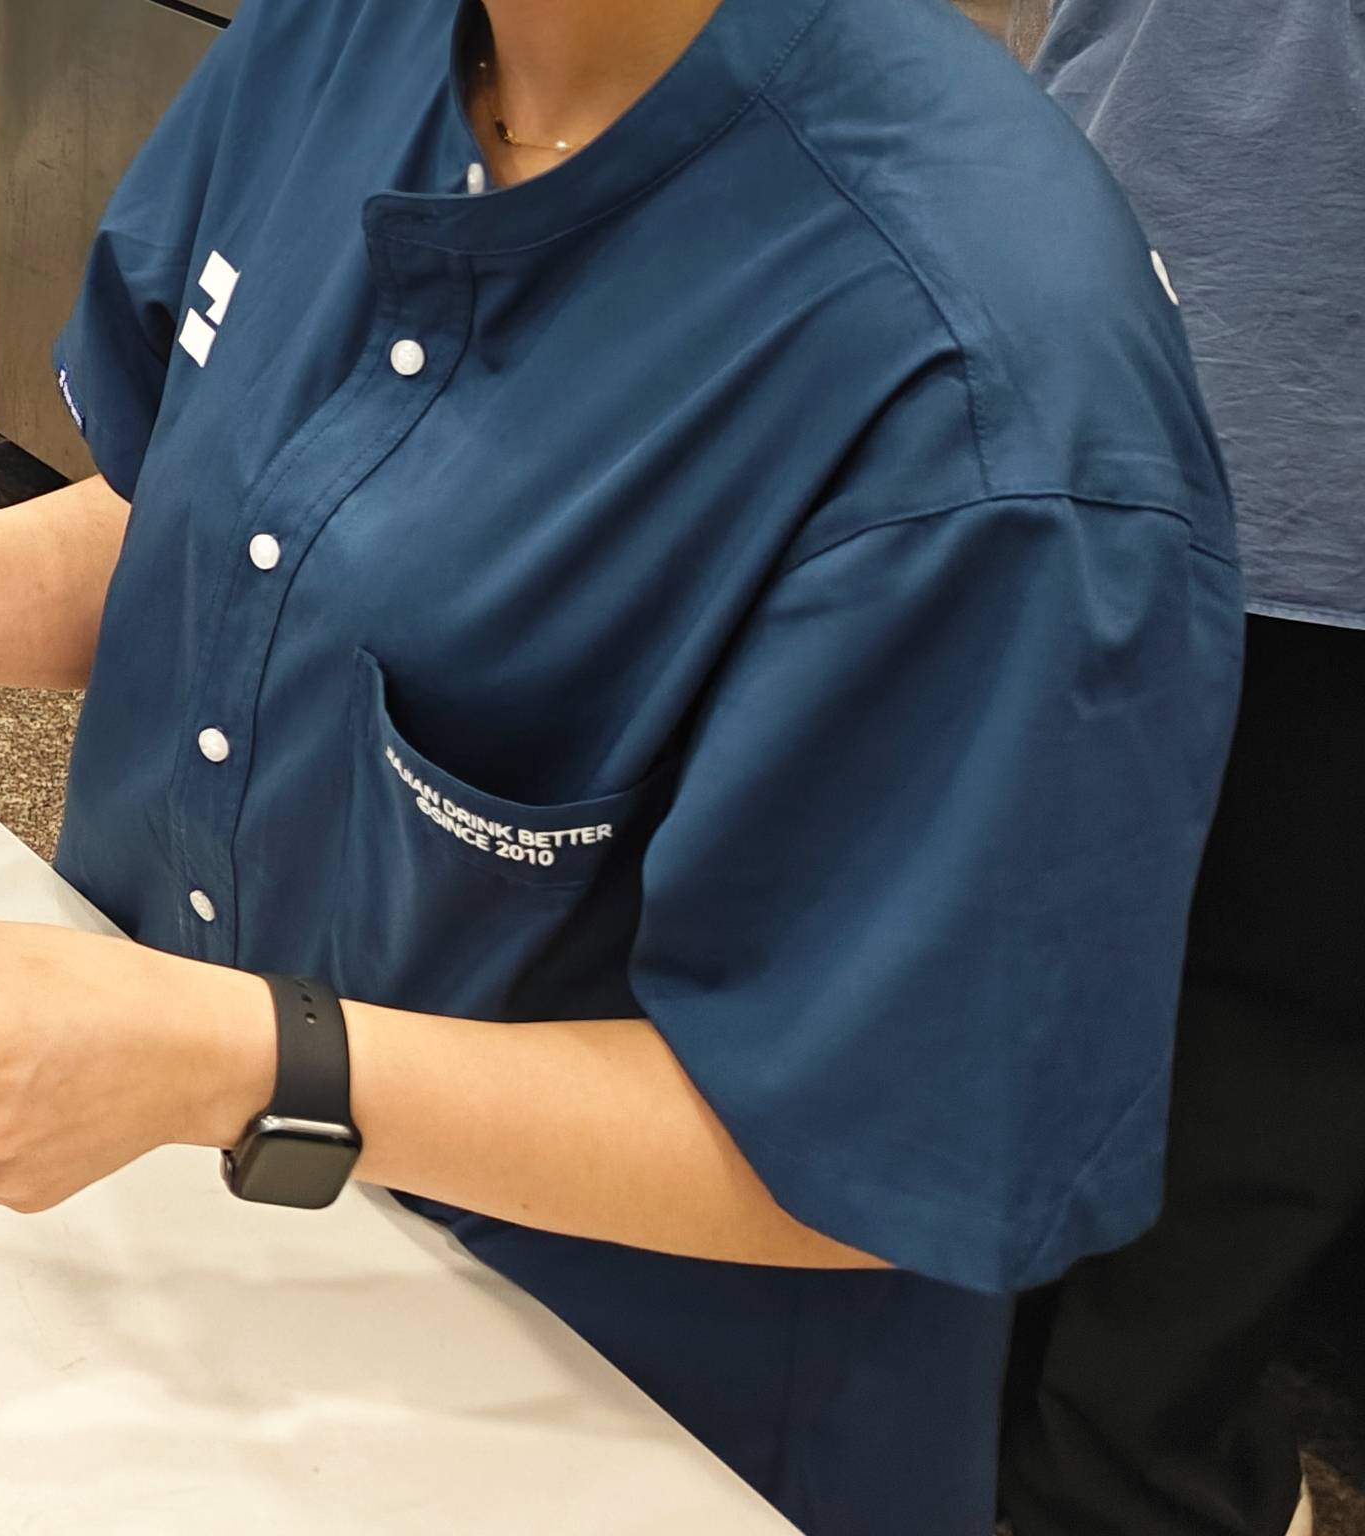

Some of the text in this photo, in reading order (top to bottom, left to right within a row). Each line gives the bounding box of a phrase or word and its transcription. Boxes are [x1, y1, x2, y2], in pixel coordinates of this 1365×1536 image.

[442, 797, 513, 843] DRINK
[517, 822, 614, 849] BETTER
[494, 839, 555, 867] 2010
